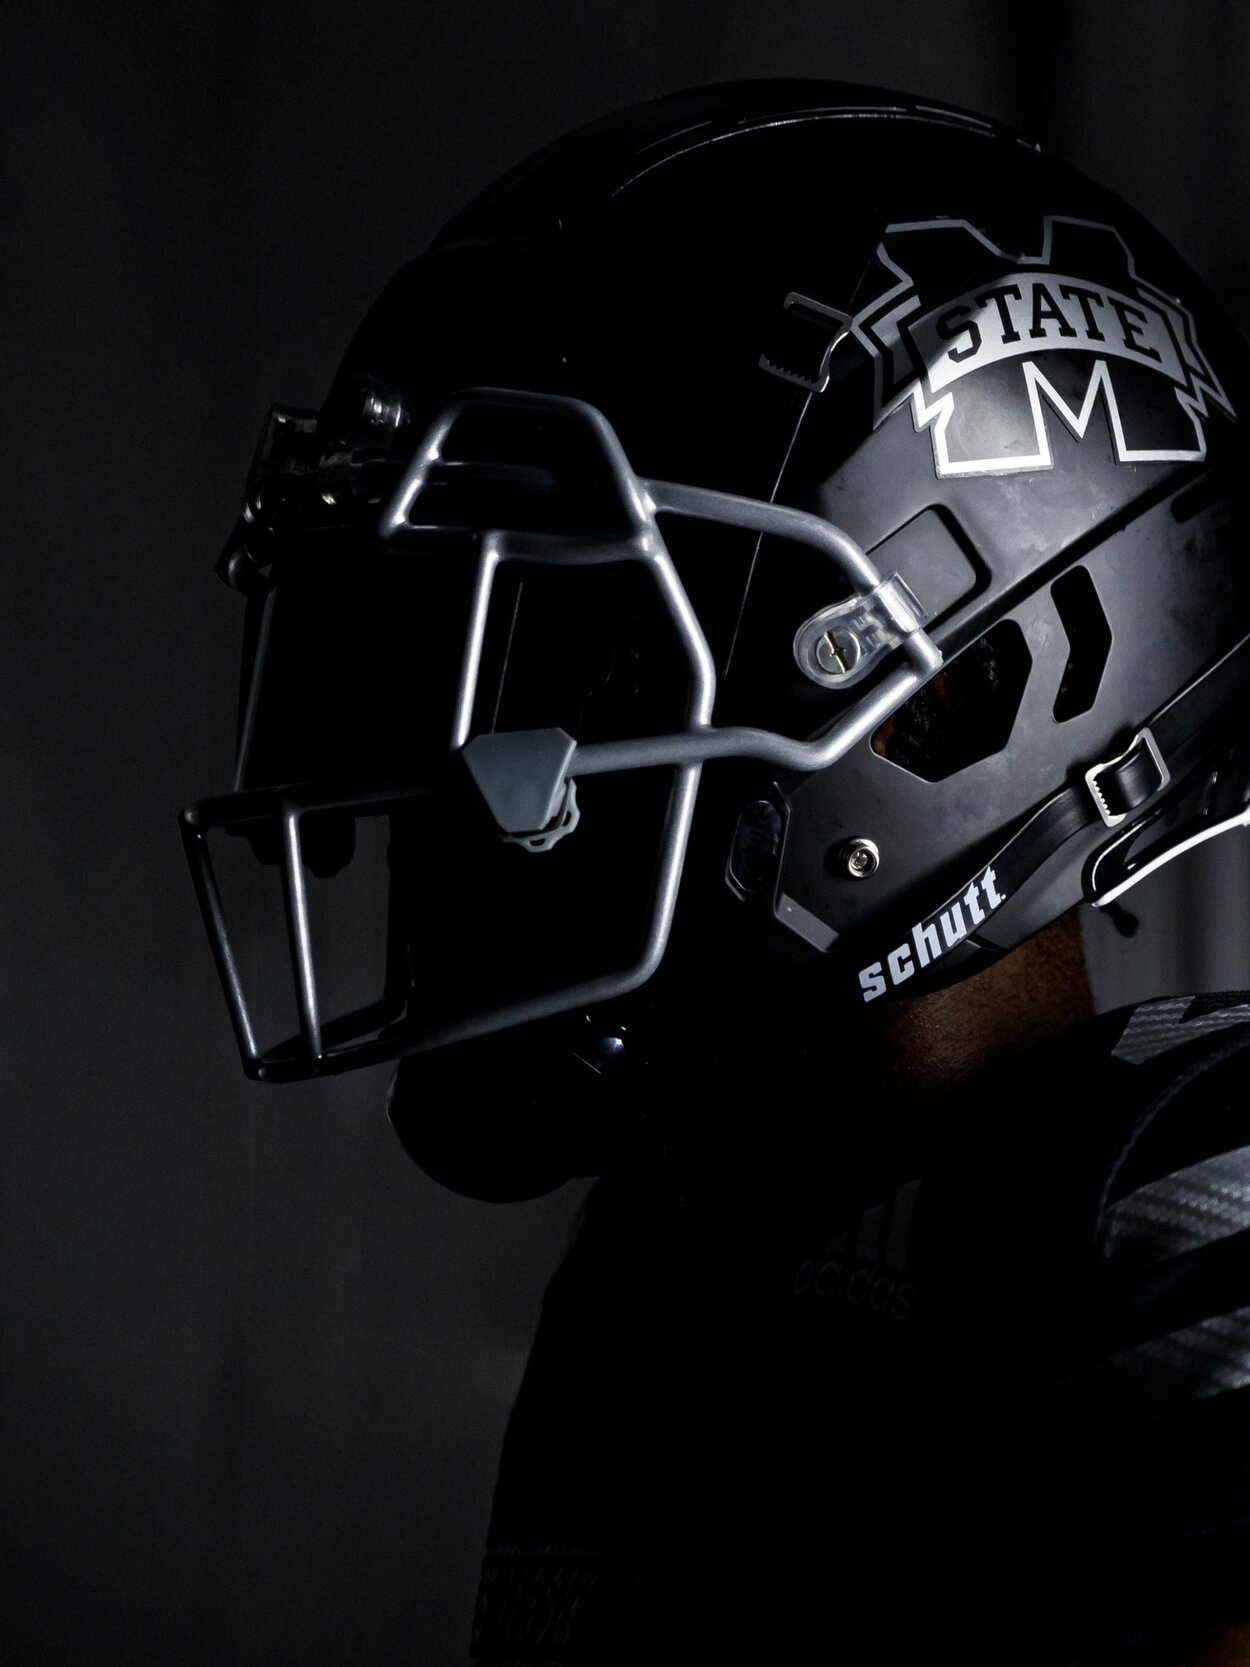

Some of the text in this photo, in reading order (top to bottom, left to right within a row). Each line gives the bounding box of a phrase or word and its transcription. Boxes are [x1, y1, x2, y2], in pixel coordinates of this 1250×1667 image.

[935, 282, 1163, 365] STATE
[857, 865, 1004, 1003] schutt
[793, 1250, 915, 1321] adidas
